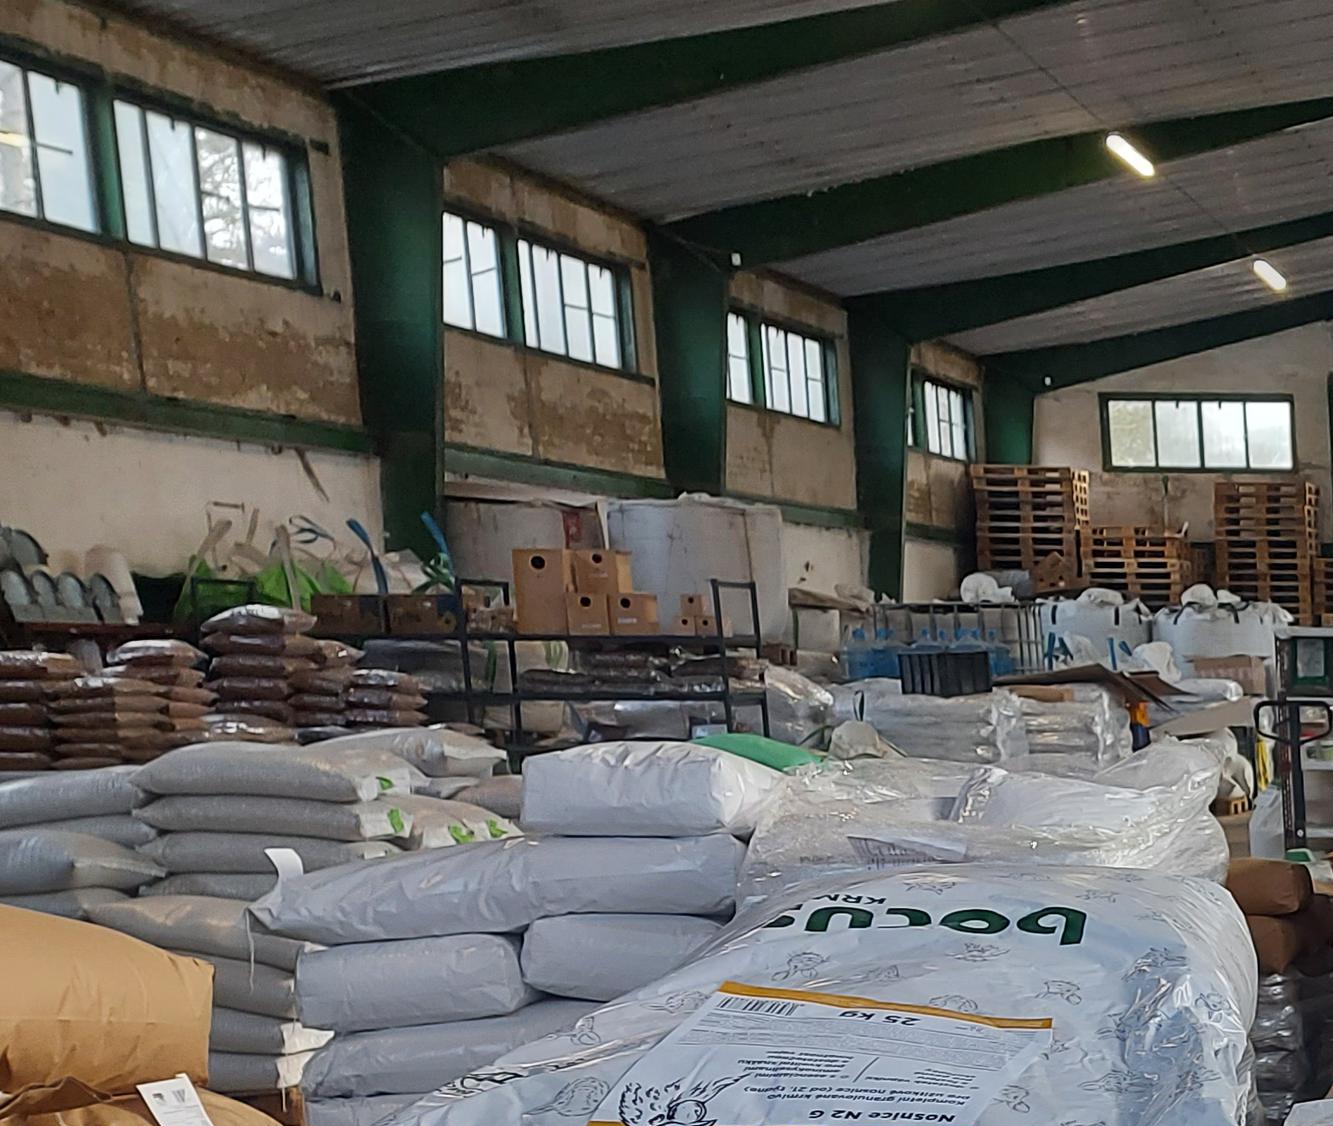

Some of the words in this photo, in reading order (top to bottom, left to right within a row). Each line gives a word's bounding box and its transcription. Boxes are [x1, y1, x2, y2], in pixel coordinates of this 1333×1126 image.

[839, 1010, 876, 1024] kg
[883, 1014, 920, 1027] 25
[809, 1110, 825, 1119] G
[830, 1110, 861, 1120] N2
[865, 1110, 955, 1123] Nosnice
